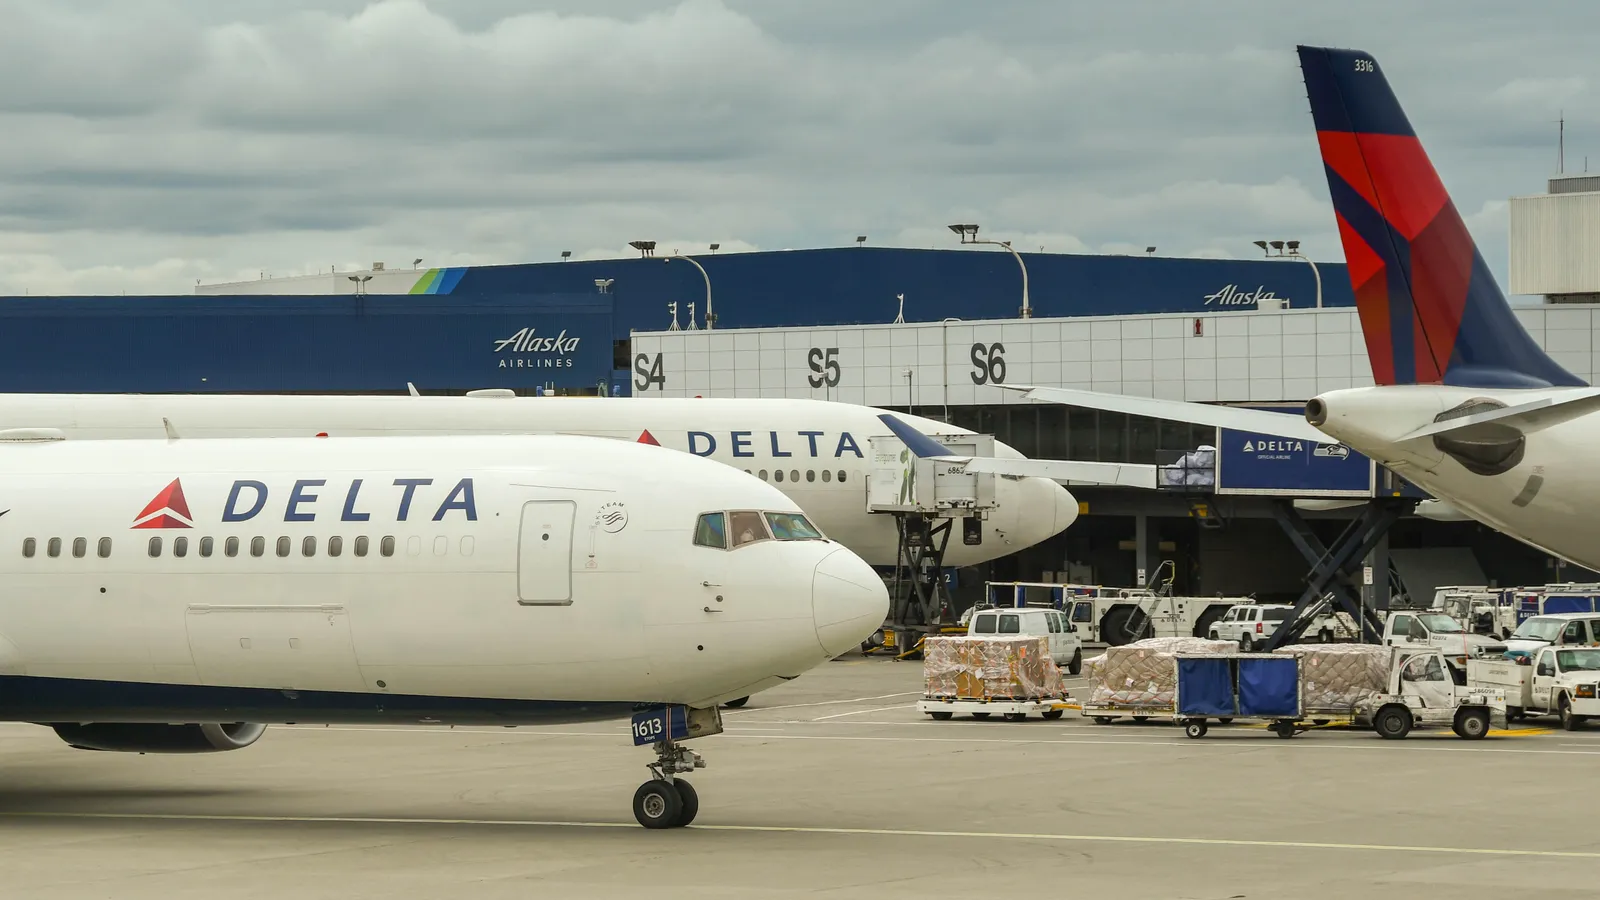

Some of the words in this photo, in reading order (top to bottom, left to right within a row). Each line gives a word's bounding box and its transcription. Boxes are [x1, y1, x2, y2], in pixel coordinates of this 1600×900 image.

[1355, 59, 1374, 72] 3316
[1203, 284, 1276, 306] Alaska
[494, 327, 580, 355] Alaska
[498, 358, 573, 368] AIRLINES
[634, 352, 666, 392] S4
[807, 347, 841, 389] S5
[970, 342, 1006, 386] S6
[687, 430, 865, 458] DELTA
[1257, 440, 1303, 452] DELTA
[221, 478, 478, 522] DELTA
[594, 501, 625, 526] SKYTEAM
[632, 718, 662, 738] 1613
